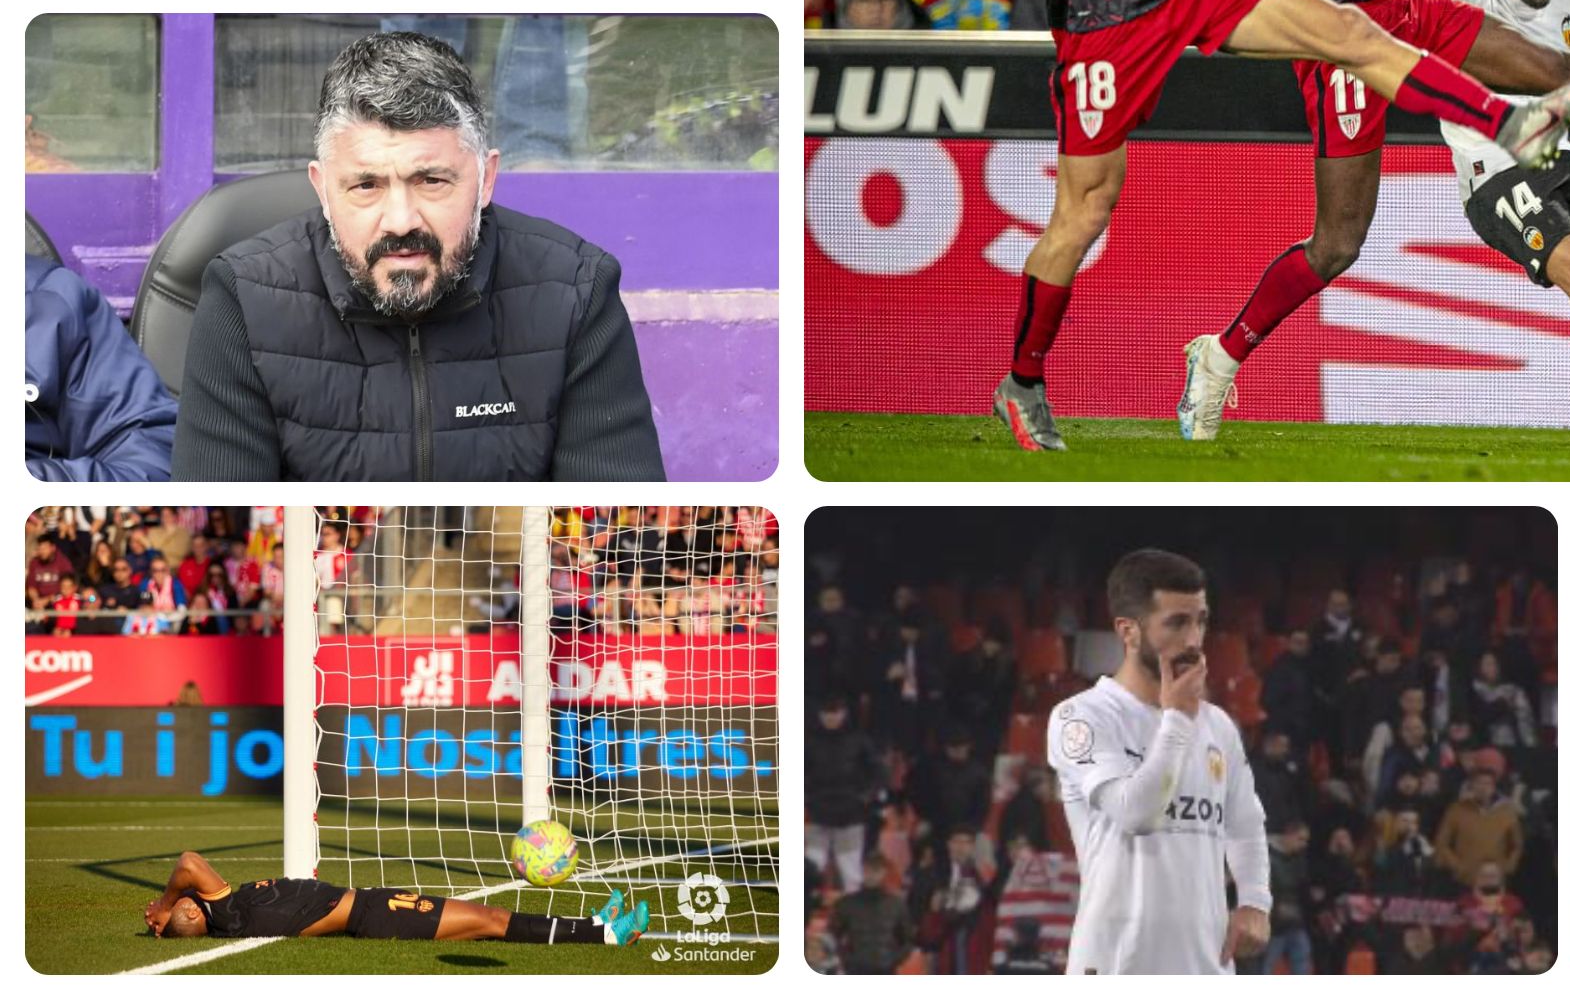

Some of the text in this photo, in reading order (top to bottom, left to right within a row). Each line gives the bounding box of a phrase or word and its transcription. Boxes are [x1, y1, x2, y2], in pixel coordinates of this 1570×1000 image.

[1068, 60, 1117, 110] 18
[1330, 68, 1366, 114] 11
[1495, 181, 1543, 233] 14
[487, 659, 668, 702] ADAR
[31, 715, 123, 778] Tu
[154, 711, 174, 776] i
[201, 711, 284, 796] jo
